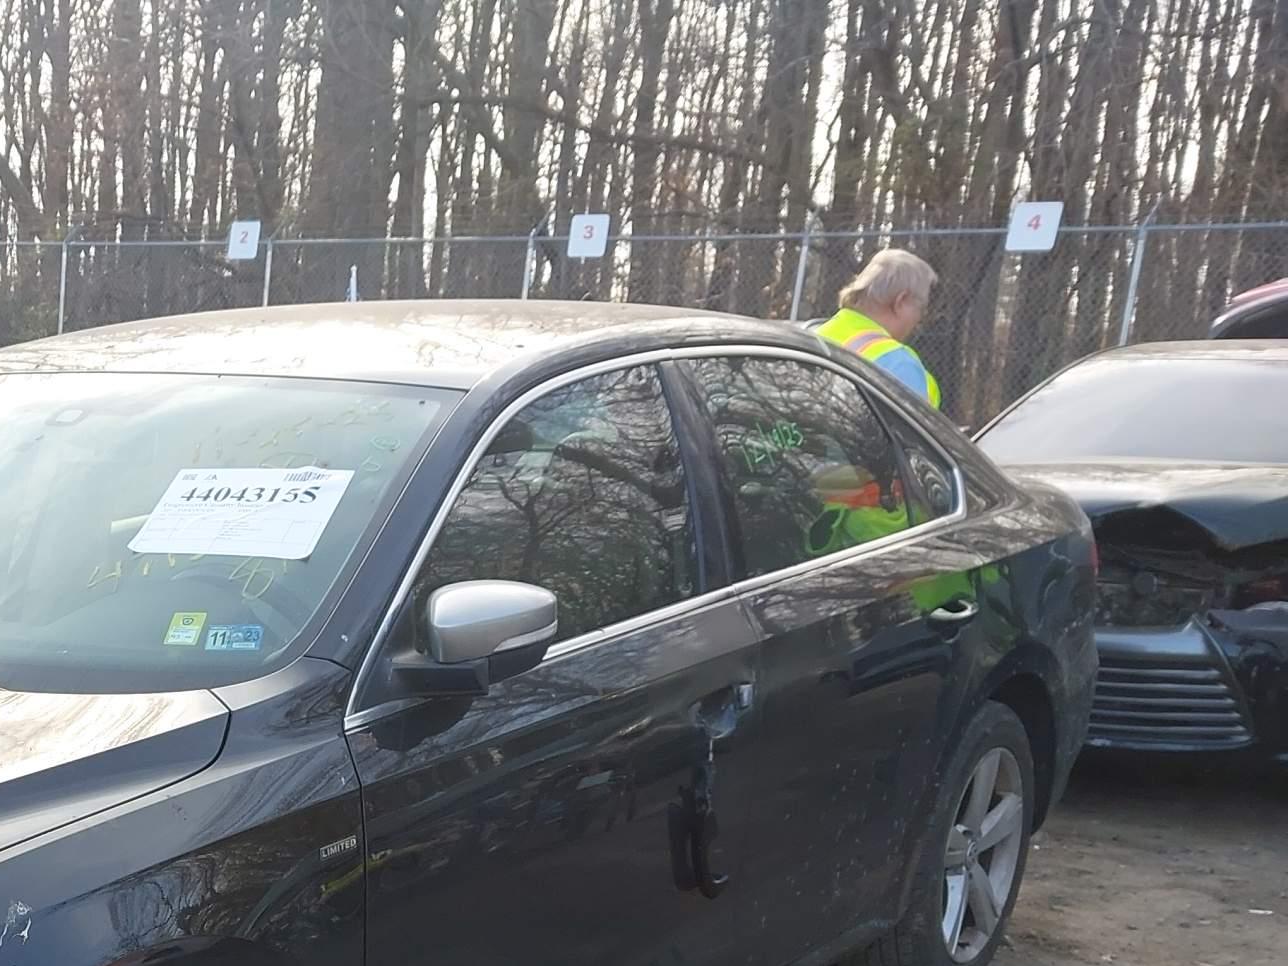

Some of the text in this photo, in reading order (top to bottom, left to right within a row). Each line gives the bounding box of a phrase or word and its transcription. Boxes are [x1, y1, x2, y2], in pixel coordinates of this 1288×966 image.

[1027, 214, 1041, 231] 4
[239, 231, 249, 244] 2
[583, 225, 594, 239] 3
[180, 486, 321, 503] 44043155
[211, 631, 228, 646] 11
[321, 838, 357, 858] LIMITED
